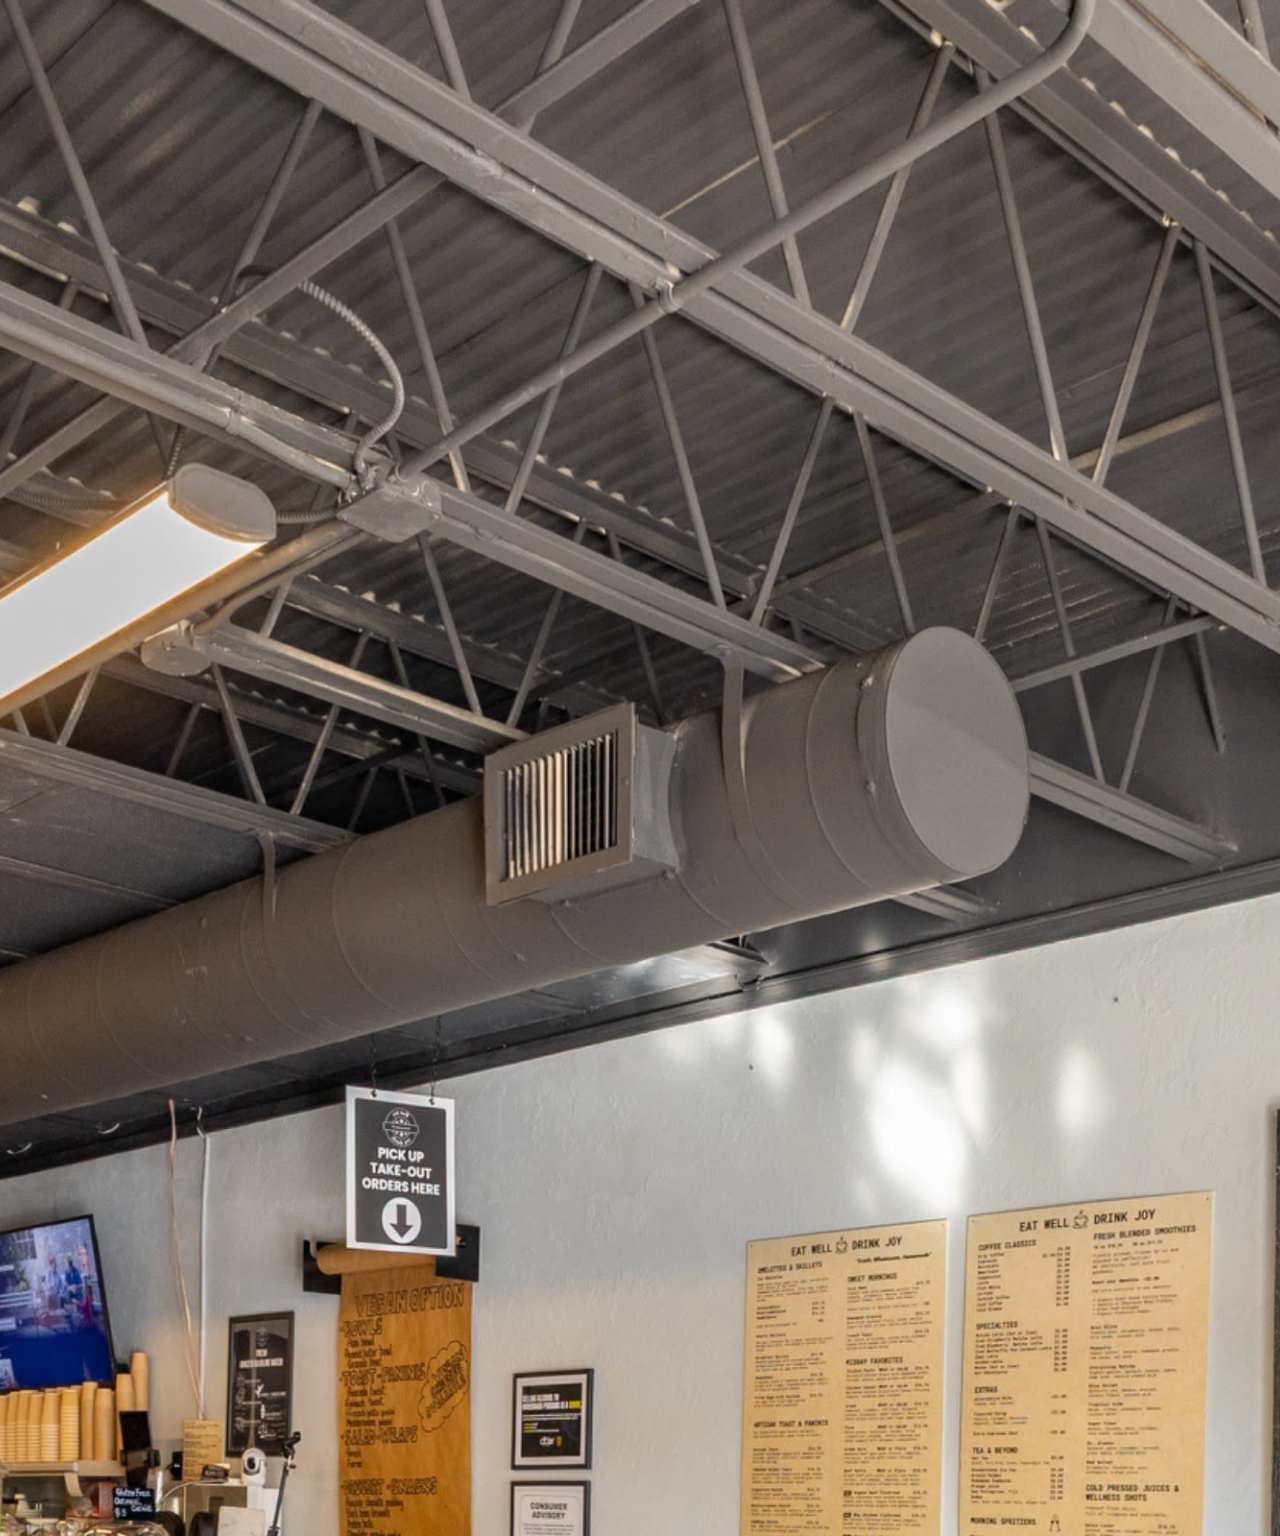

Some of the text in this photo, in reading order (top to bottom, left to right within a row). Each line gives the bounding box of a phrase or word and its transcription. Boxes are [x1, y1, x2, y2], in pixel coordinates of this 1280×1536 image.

[377, 1147, 424, 1163] PICK UP
[370, 1162, 432, 1179] TAKE-OUT
[362, 1177, 440, 1196] ORDERS HERE
[1020, 1209, 1155, 1232] EAT WELL DRINK JOY
[1093, 1225, 1196, 1240] FRESH BLENDED SMOOTHIES
[791, 1236, 903, 1257] EAT WELL DRINK JOY
[978, 1240, 1036, 1251] COFFEE CLASSICS
[976, 1321, 1018, 1330] SPECIALTIES
[974, 1386, 998, 1394] EXTRAS
[972, 1446, 985, 1455] TEA
[995, 1446, 1018, 1454] BEYOND
[1086, 1484, 1103, 1492] COLD
[1107, 1484, 1138, 1493] PRESSED
[1142, 1484, 1170, 1492] JUICES
[1085, 1493, 1147, 1502] WELLNESS SHOTS
[530, 1502, 567, 1511] CONSUMER
[531, 1511, 565, 1520] ADVISORY
